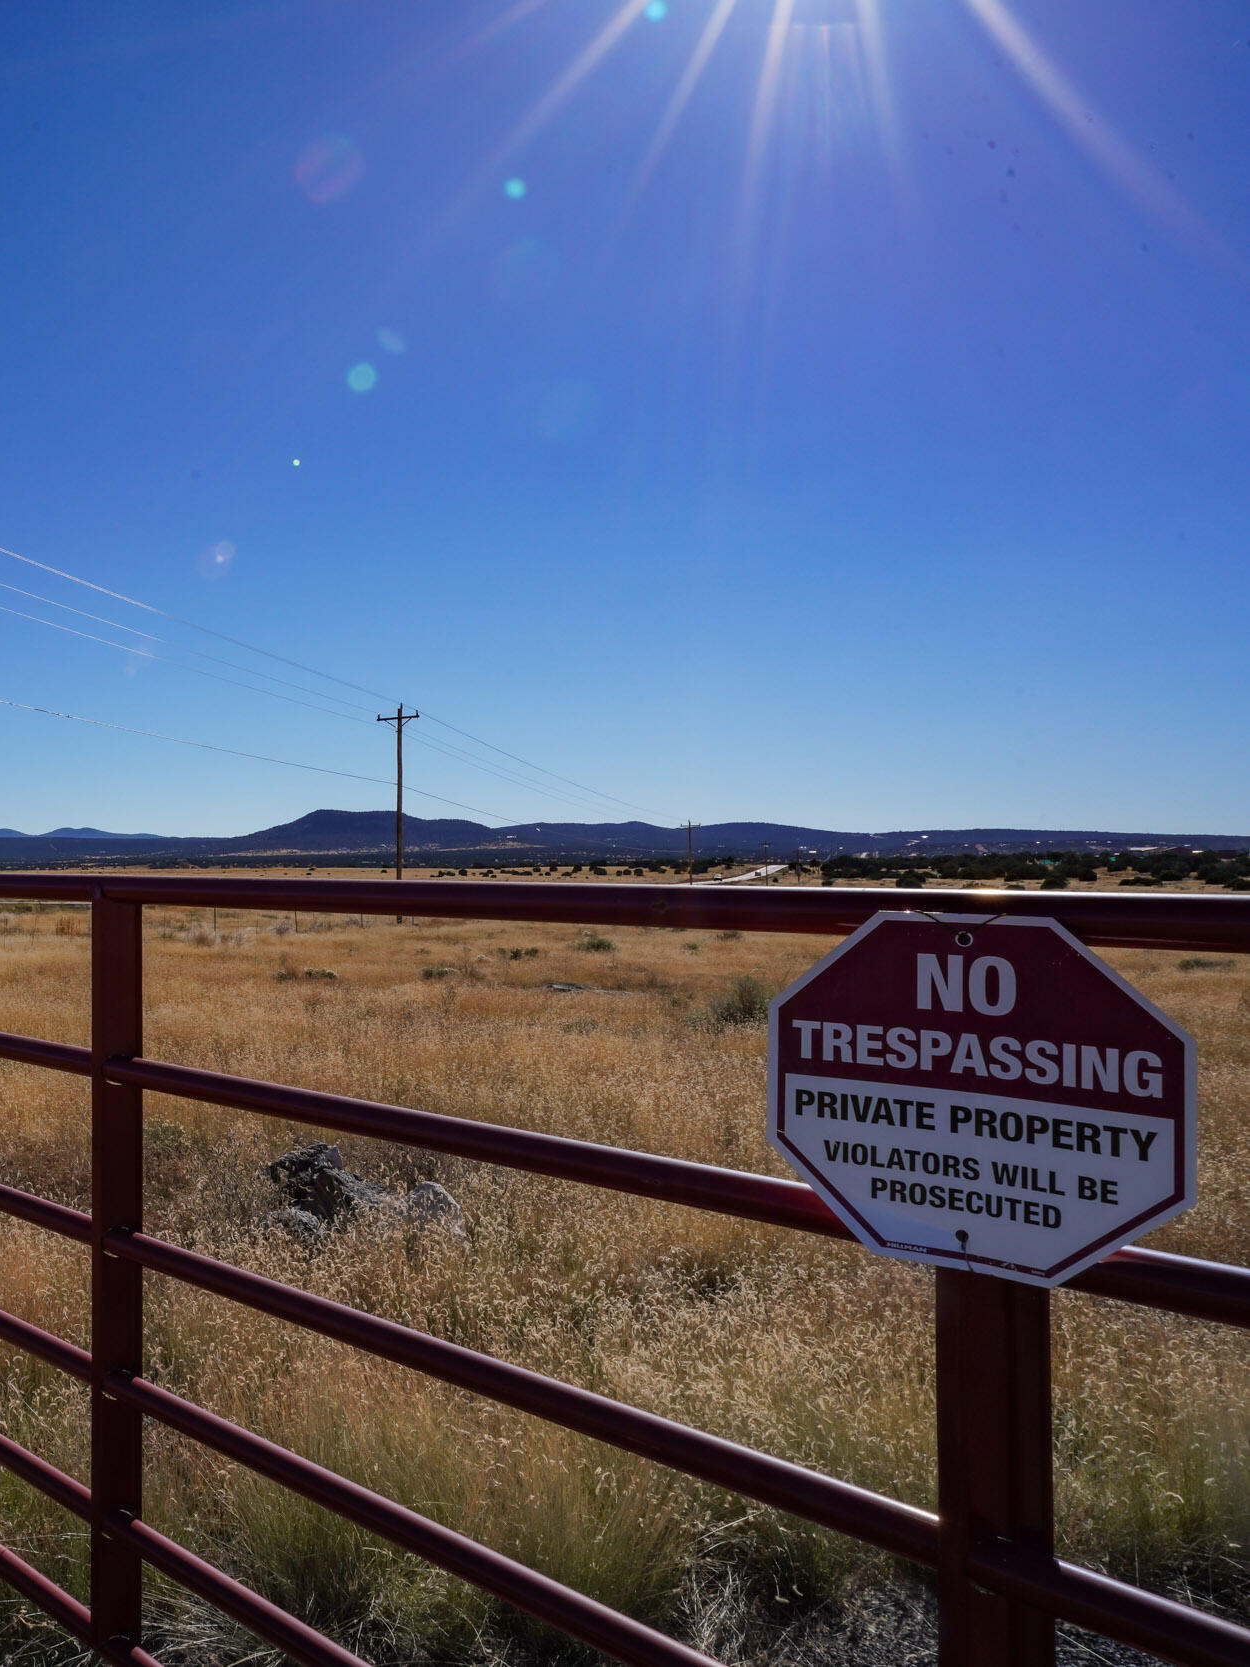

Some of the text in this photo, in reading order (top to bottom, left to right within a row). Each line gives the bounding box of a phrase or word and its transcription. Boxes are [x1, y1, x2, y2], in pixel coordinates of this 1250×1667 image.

[916, 953, 1016, 1016] NO
[792, 1019, 1164, 1098] TRESPASSING
[795, 1088, 1158, 1162] PRIVATE PROPERTY
[823, 1139, 1119, 1205] VIOLATORS WILL BE
[870, 1177, 1062, 1229] PROSECUTED
